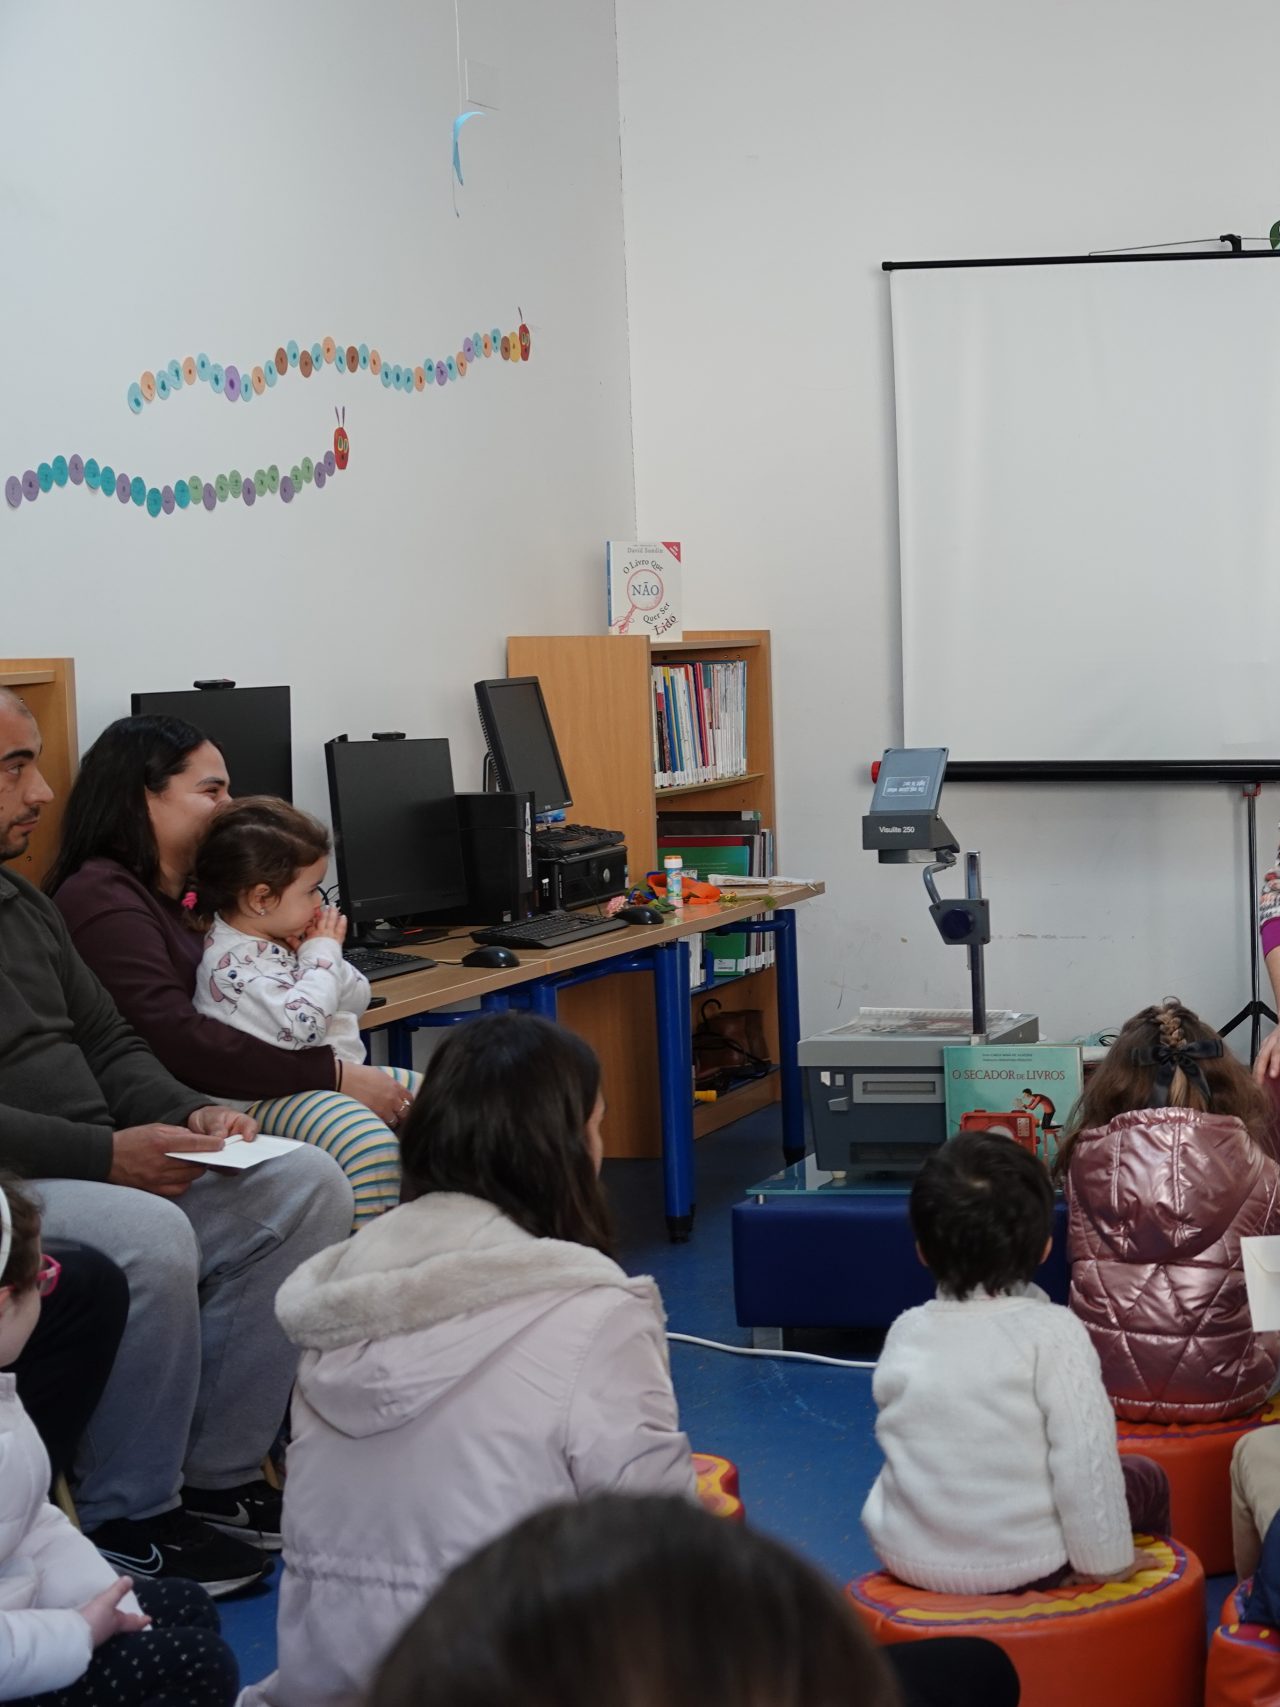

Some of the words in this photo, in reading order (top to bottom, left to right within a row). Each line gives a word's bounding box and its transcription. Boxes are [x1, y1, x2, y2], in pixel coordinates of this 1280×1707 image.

[623, 566, 630, 575] O
[629, 559, 650, 570] Livro
[650, 560, 664, 571] Que
[643, 613, 661, 625] Quer
[659, 602, 670, 615] Ser
[653, 614, 677, 636] Lido
[952, 1069, 962, 1080] O
[964, 1069, 1015, 1080] SECADOR
[1026, 1070, 1066, 1080] LIVROS
